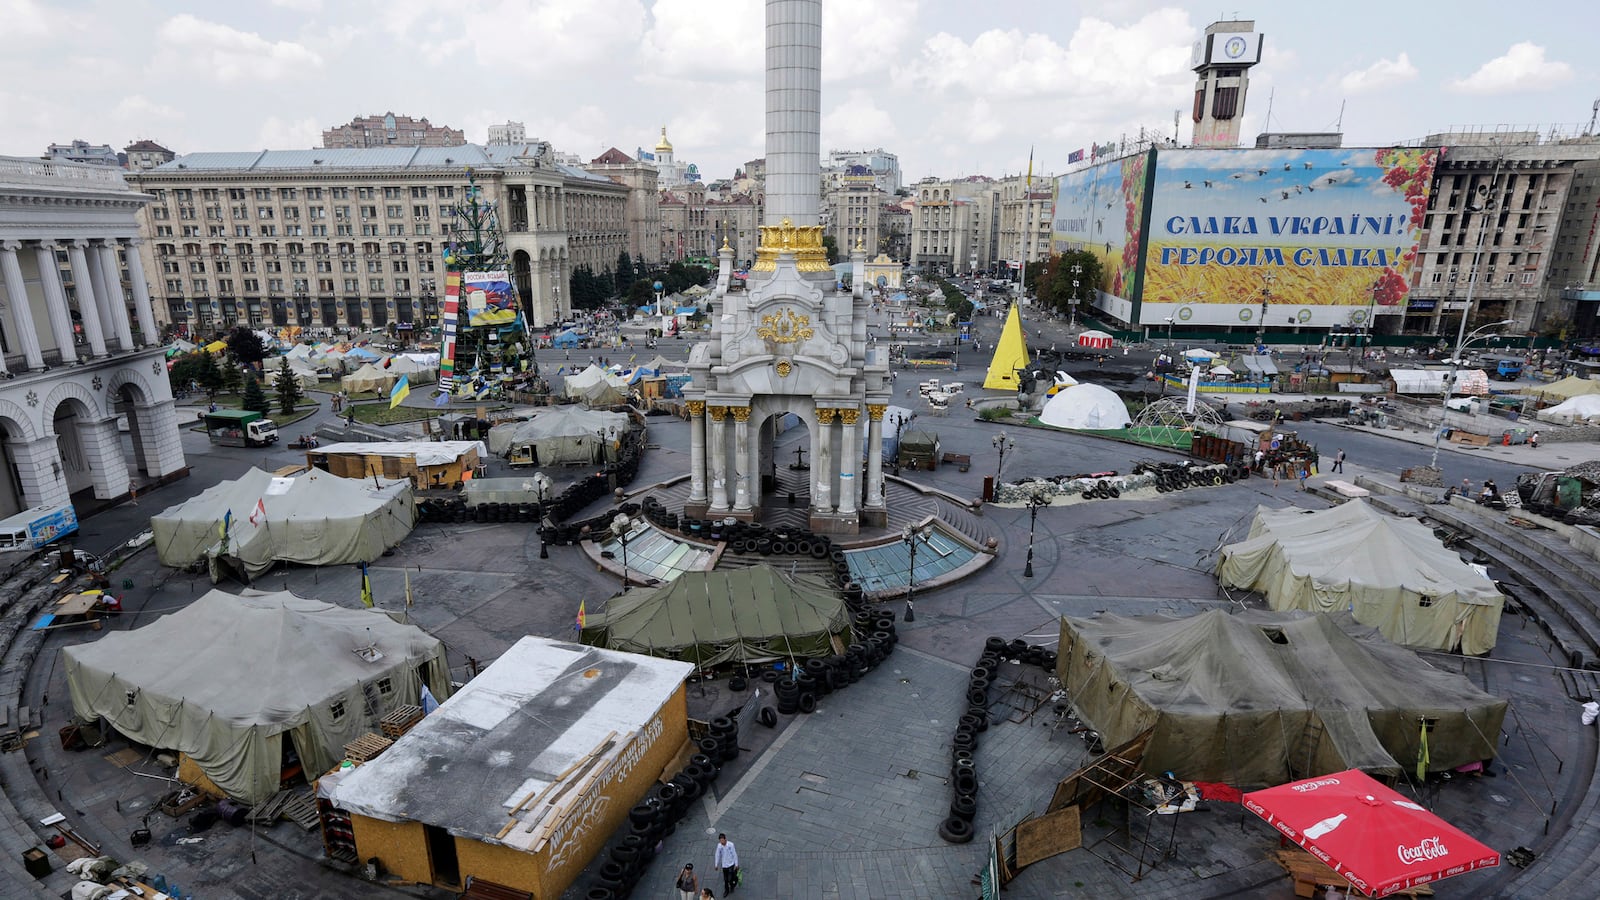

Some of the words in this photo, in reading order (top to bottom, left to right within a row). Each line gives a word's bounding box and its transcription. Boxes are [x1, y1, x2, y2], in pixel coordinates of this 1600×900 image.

[1166, 215, 1259, 235] СЛАВА
[1161, 246, 1286, 267] ГЕРОЯМ
[1292, 246, 1402, 267] СЛАВА!
[1397, 835, 1449, 865] Coca-Cola
